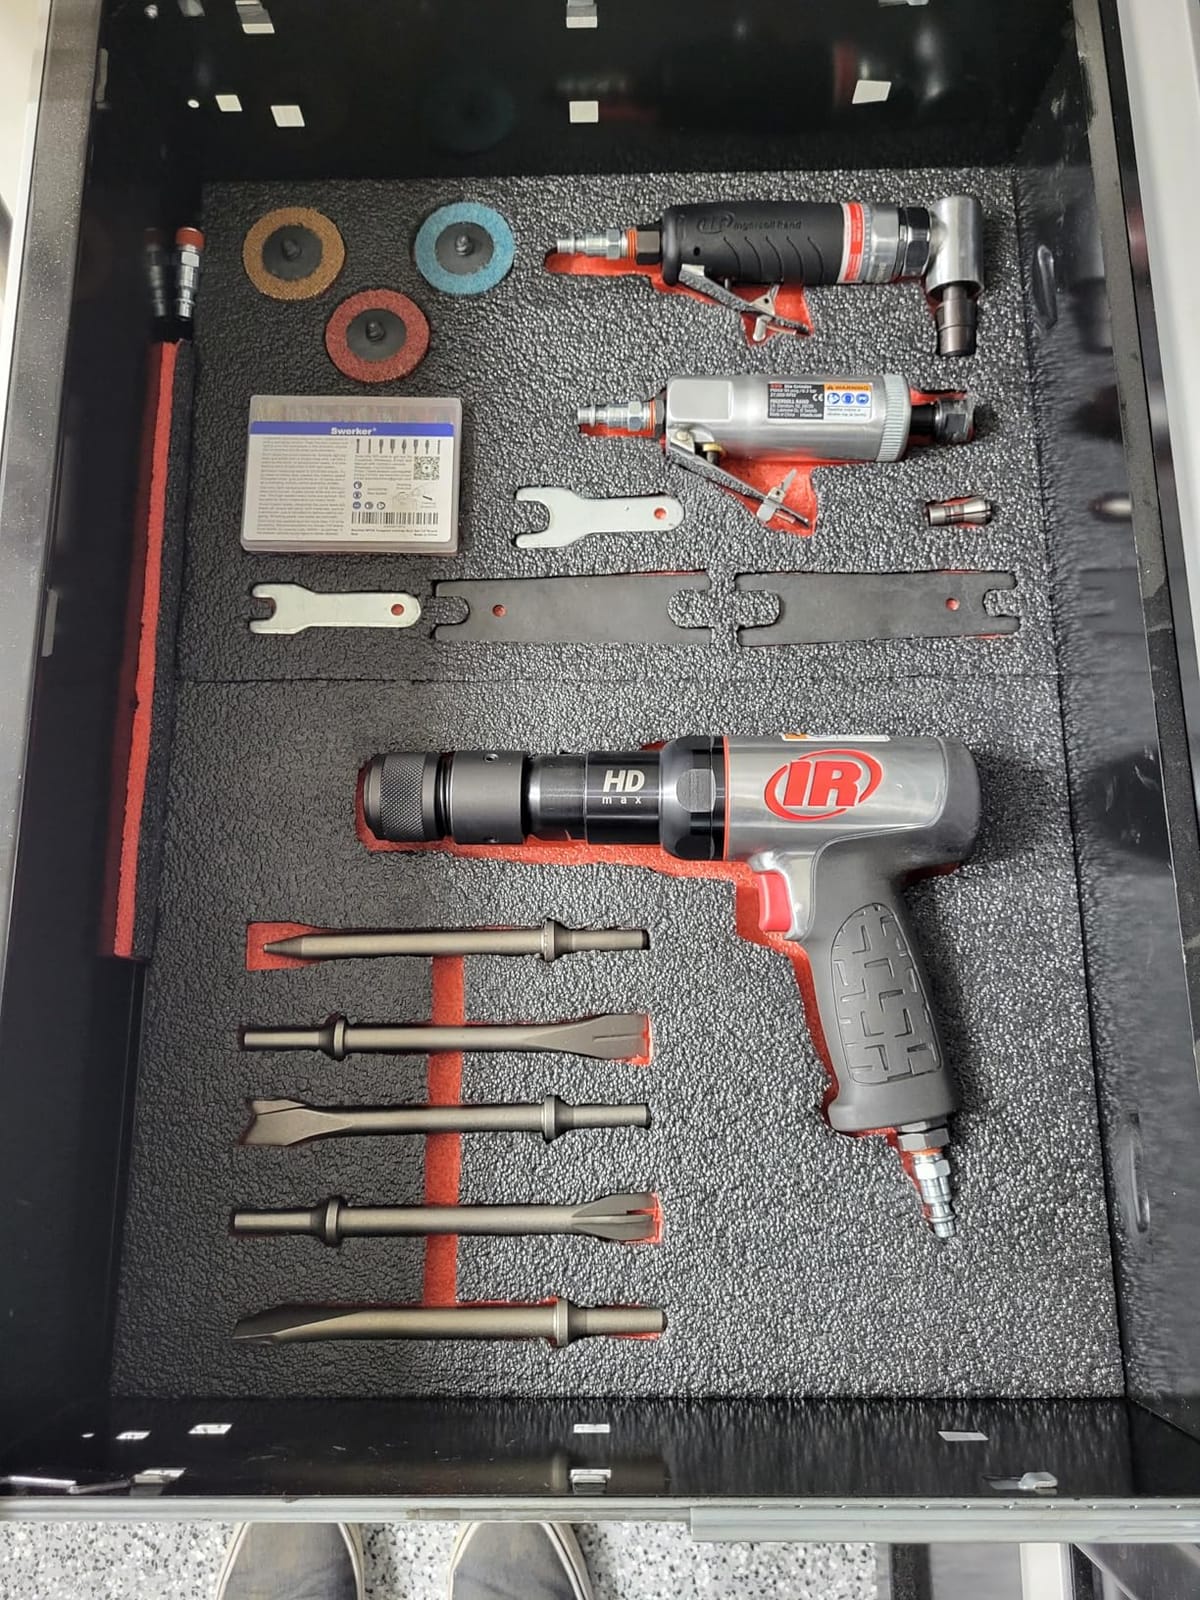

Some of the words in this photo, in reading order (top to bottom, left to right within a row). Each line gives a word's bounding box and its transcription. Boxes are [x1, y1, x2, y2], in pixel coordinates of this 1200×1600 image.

[603, 769, 645, 793] HD
[782, 759, 862, 808] IR
[602, 796, 642, 805] max
